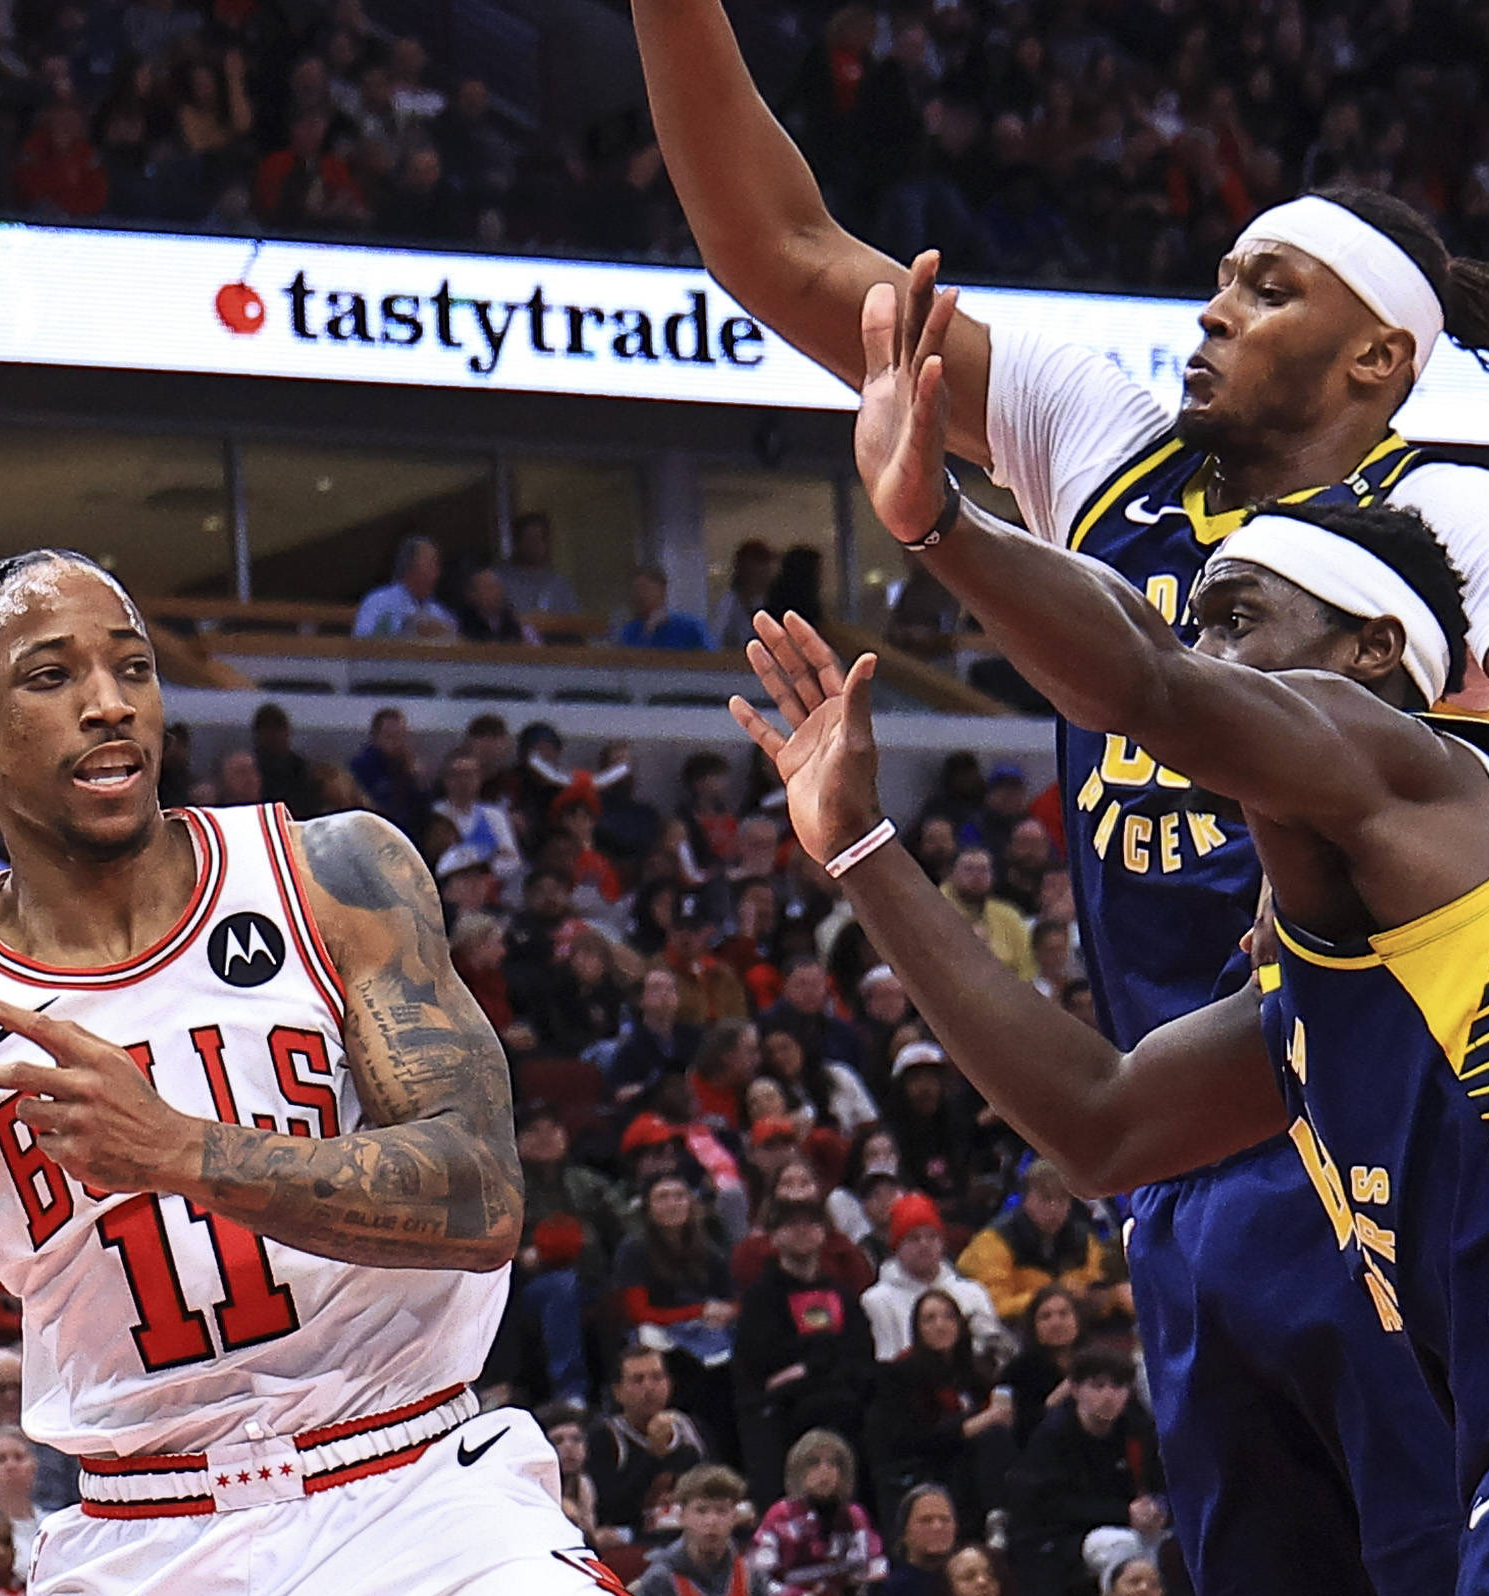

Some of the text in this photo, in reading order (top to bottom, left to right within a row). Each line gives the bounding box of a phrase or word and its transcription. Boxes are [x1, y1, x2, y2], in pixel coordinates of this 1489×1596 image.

[284, 270, 764, 374] tastytrade
[1077, 766, 1228, 876] PACER
[96, 1192, 302, 1374] 11
